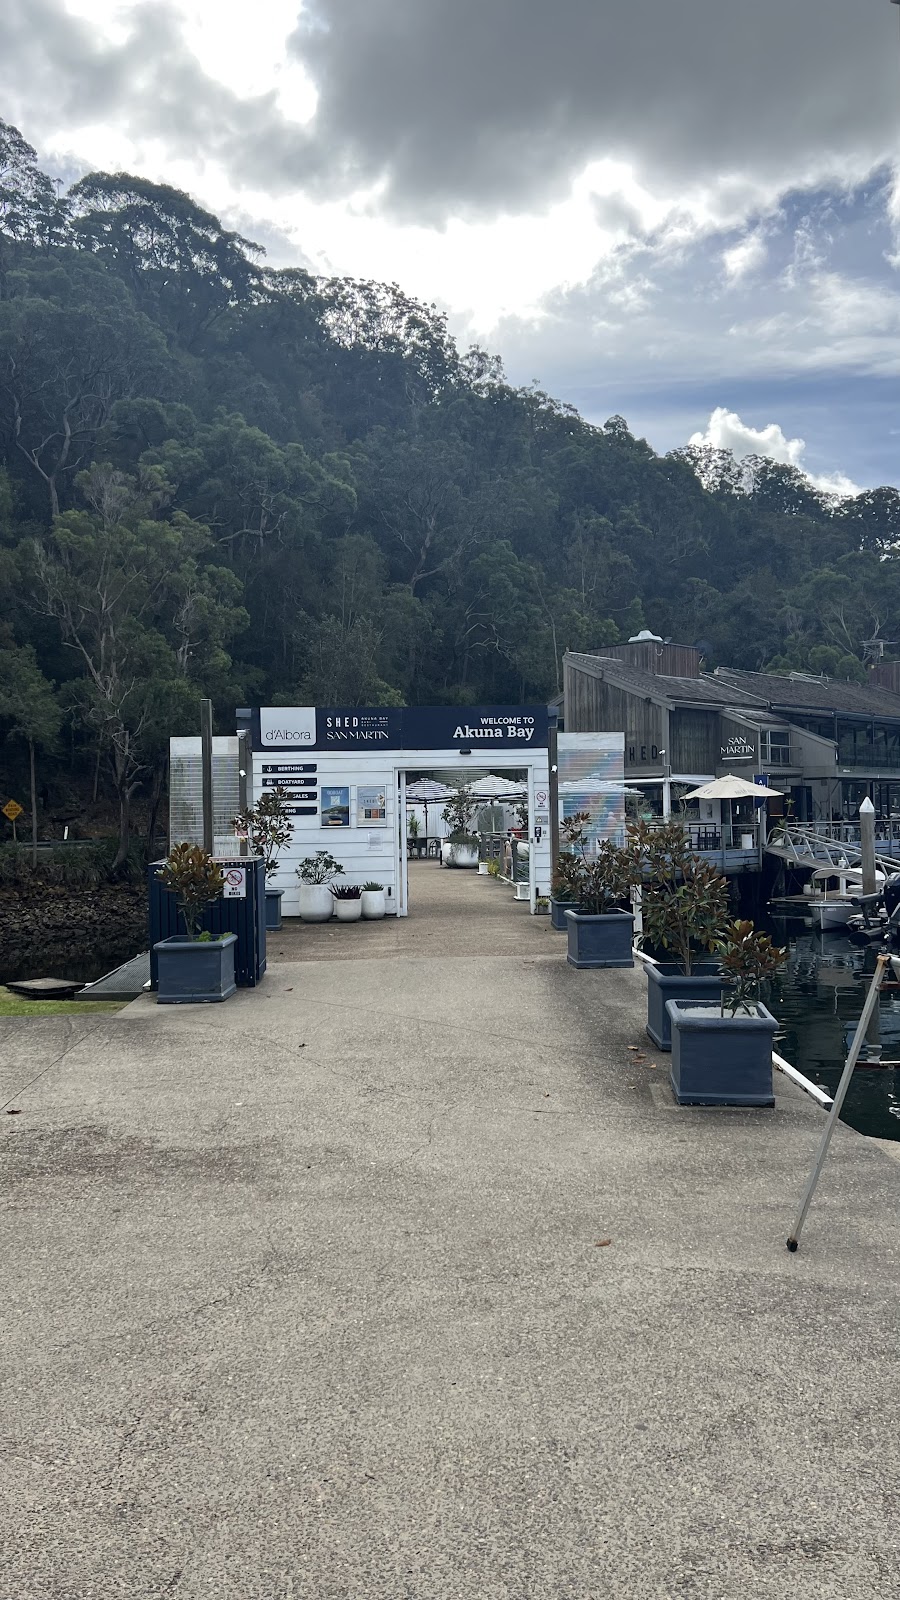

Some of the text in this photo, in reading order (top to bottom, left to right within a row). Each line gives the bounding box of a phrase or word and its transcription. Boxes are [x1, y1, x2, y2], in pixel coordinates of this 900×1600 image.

[326, 716, 359, 728] SHED
[480, 716, 535, 725] WELCOME TO
[265, 729, 312, 741] d'Albora
[326, 730, 389, 740] SAN MARTIN
[453, 725, 535, 741] Akuna Bay
[728, 736, 747, 746] SAN
[629, 744, 658, 762] HED
[720, 744, 755, 754] MARTIN
